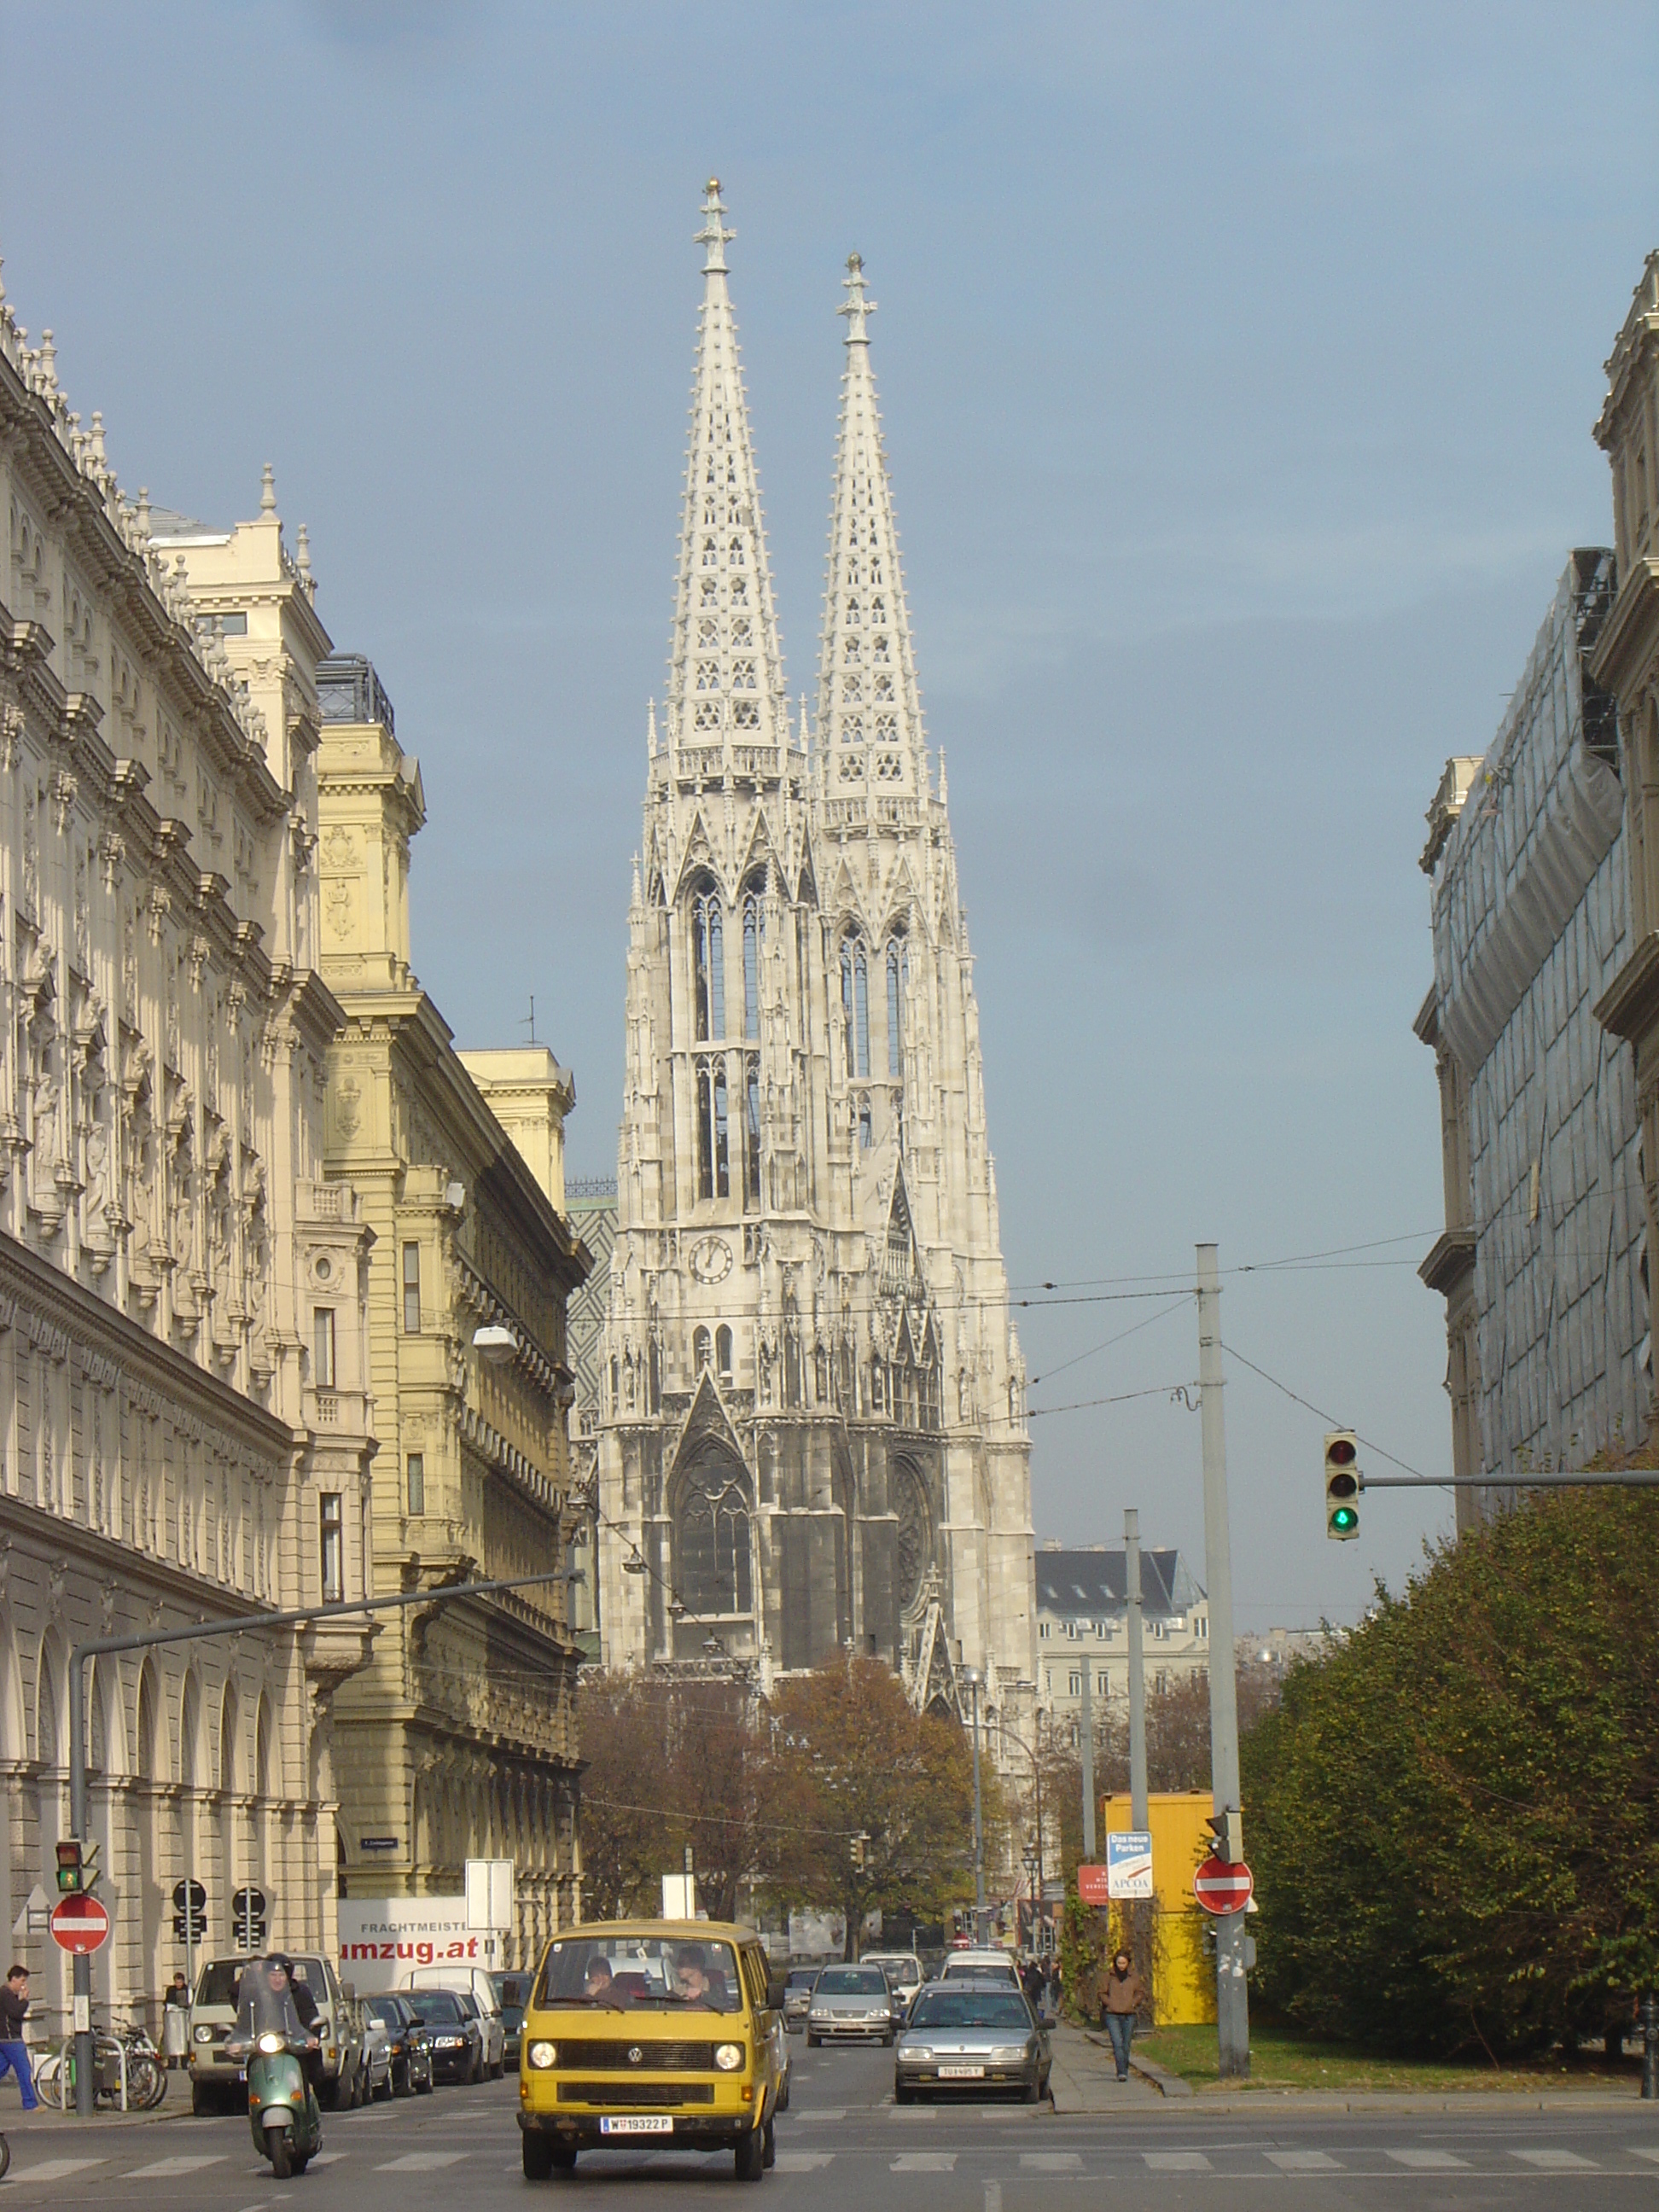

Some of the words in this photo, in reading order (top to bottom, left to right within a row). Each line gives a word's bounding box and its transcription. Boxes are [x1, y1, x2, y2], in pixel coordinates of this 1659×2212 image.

[1111, 1835, 1126, 1843] Das
[1114, 1878, 1148, 1888] APCOA
[611, 2119, 619, 2129] W
[628, 2119, 659, 2129] 19322
